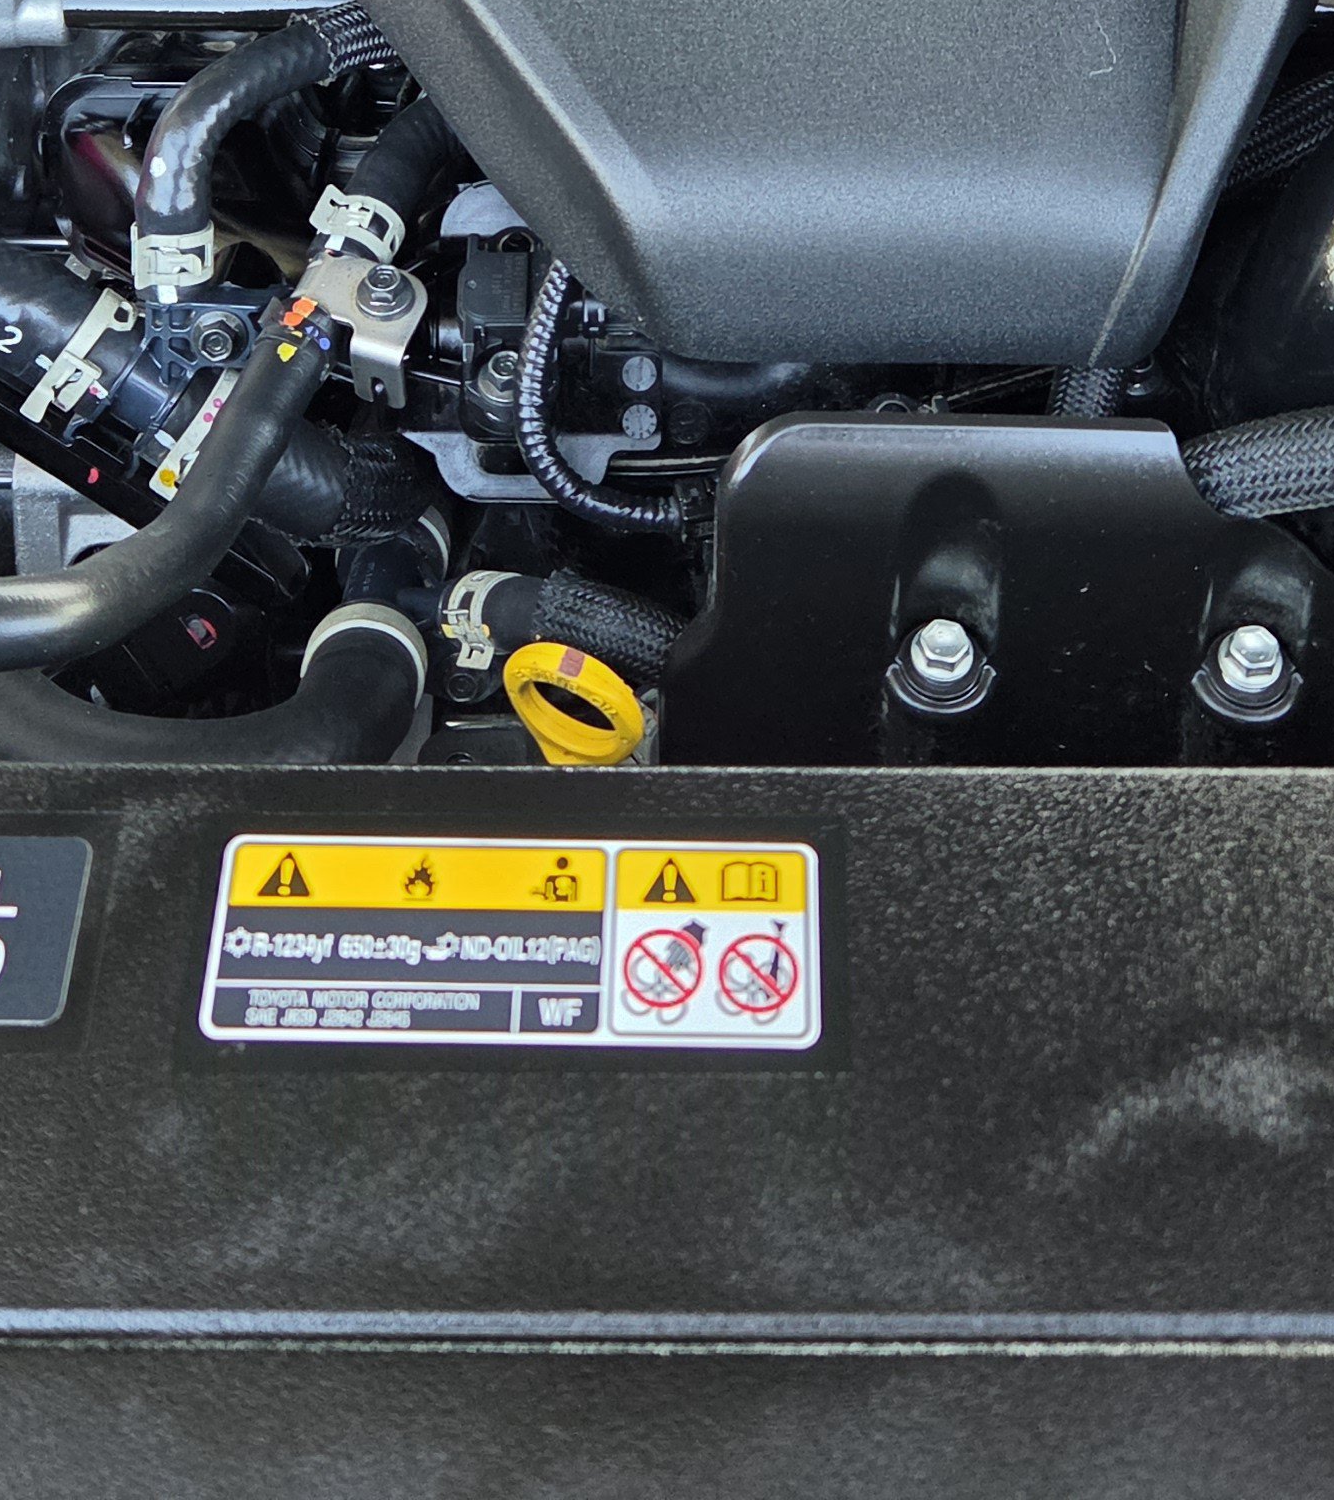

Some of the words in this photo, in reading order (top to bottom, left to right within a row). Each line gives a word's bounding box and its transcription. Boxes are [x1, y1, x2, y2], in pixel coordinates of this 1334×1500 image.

[250, 932, 336, 965] R-1234yf
[246, 988, 310, 1009] TOYOTA
[311, 989, 370, 1010] MOTOR
[370, 990, 481, 1012] CORPORATION
[538, 997, 584, 1028] WF
